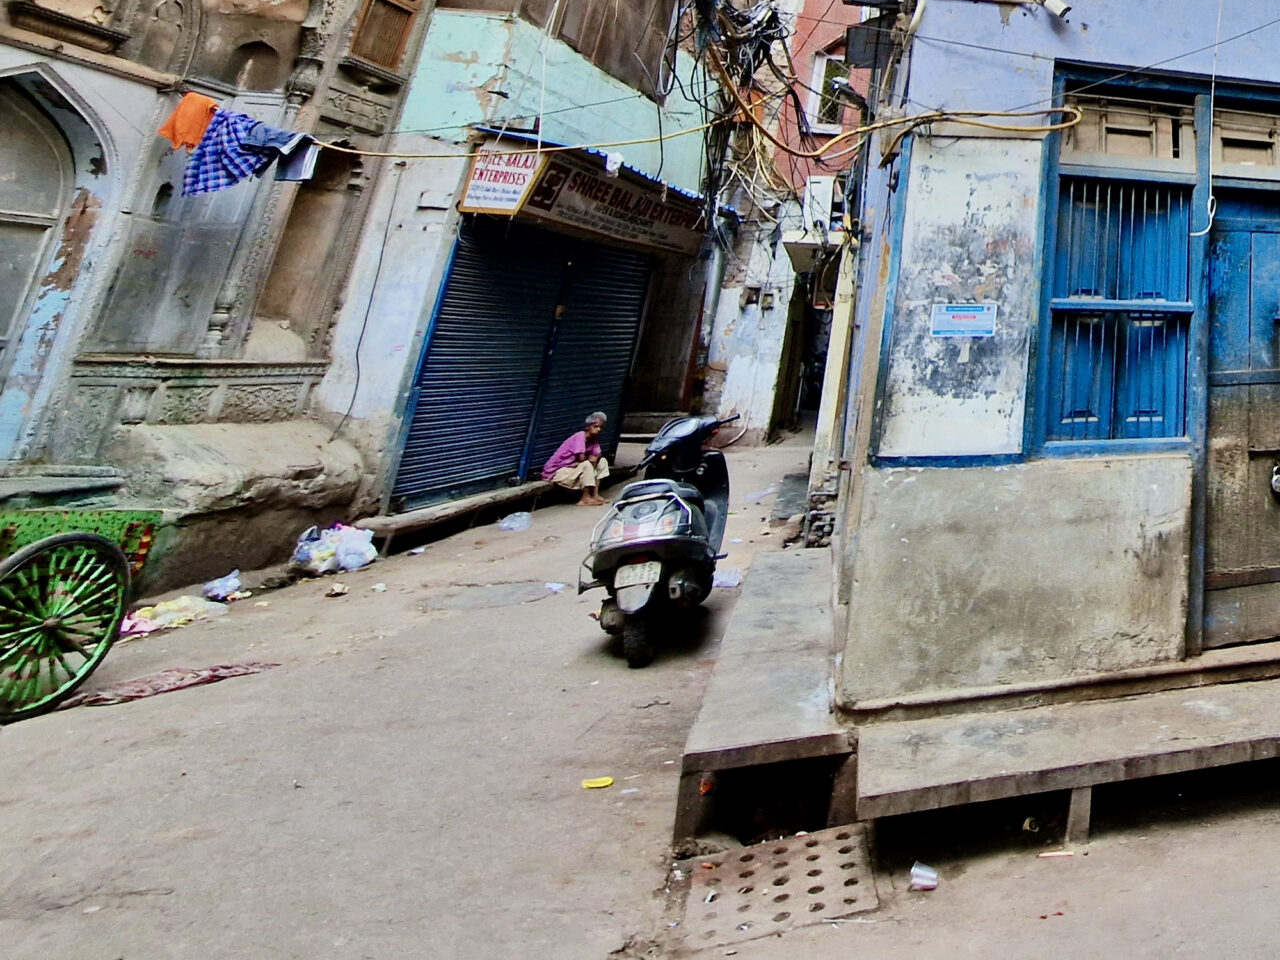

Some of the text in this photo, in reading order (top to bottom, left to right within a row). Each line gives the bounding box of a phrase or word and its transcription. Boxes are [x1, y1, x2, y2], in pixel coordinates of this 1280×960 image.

[505, 152, 537, 170] BALAJI
[473, 167, 528, 186] ENTERPRISES
[567, 171, 613, 204] SHREE
[610, 187, 654, 218] BALAJI
